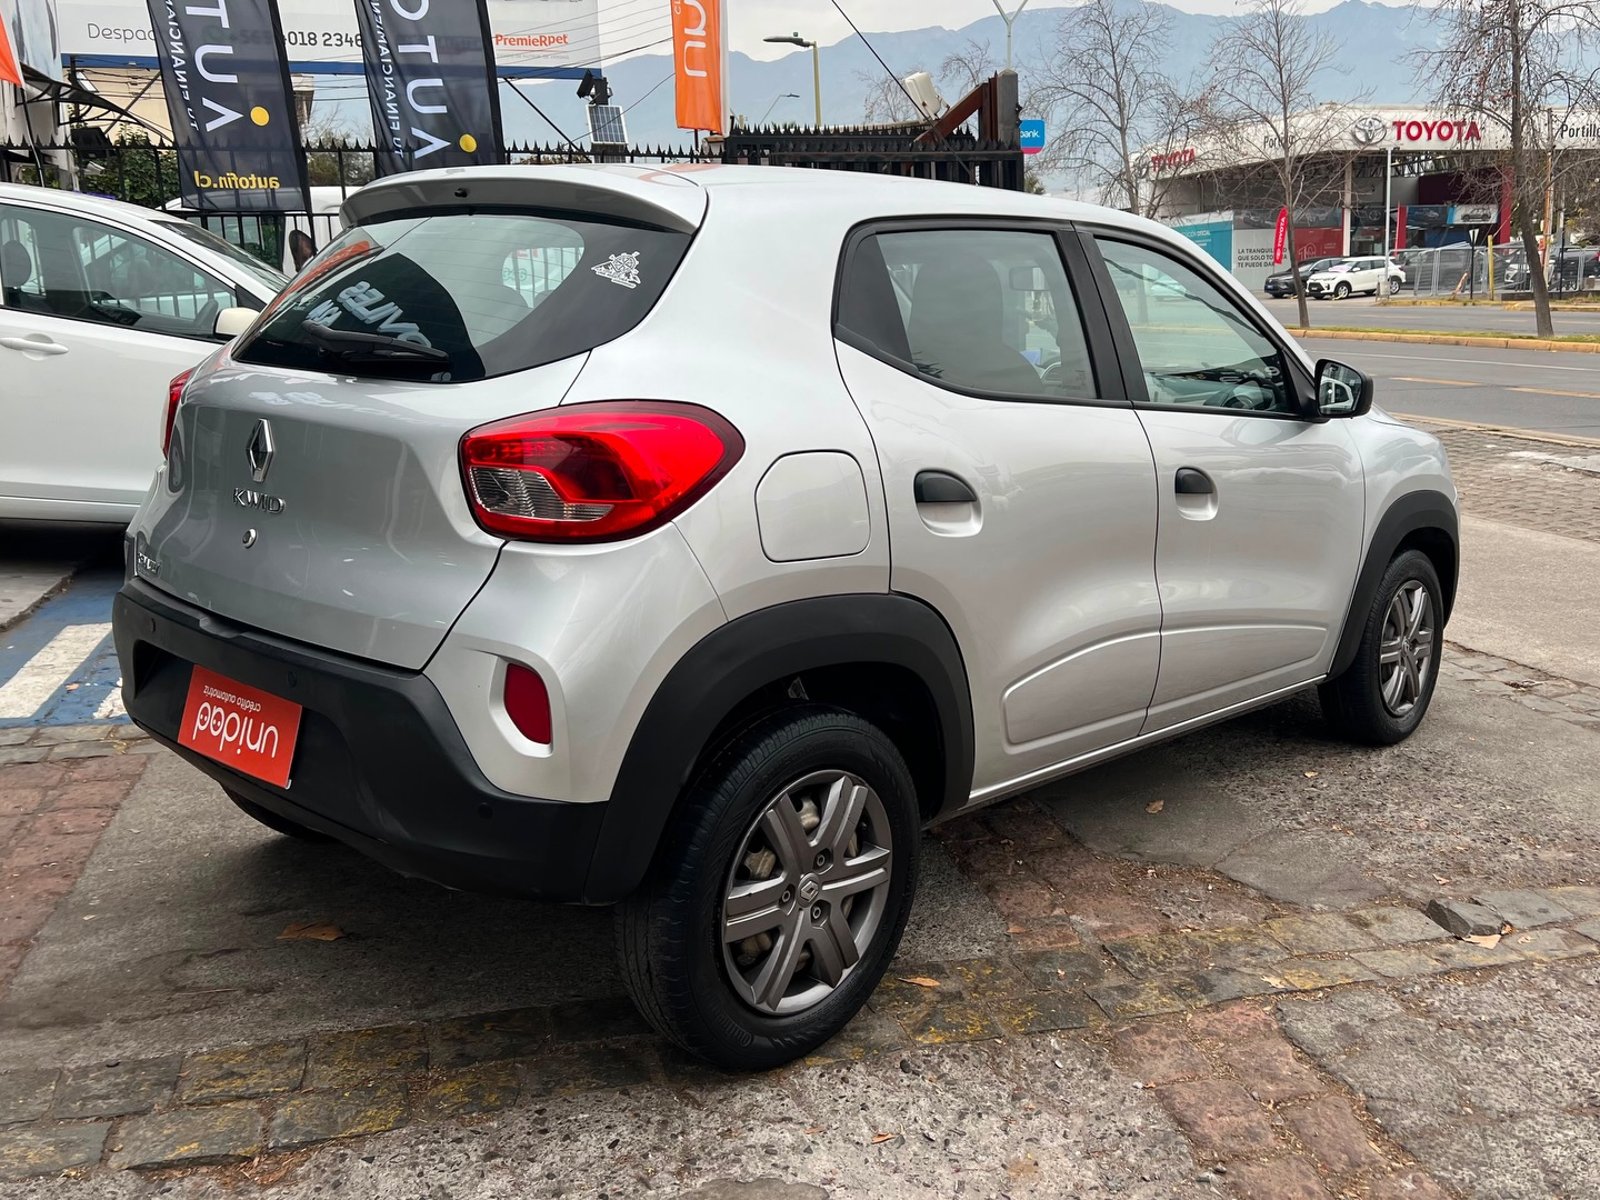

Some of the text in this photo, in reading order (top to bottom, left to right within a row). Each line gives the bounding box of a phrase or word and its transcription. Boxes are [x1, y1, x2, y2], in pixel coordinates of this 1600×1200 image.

[283, 31, 318, 46] 018
[495, 34, 568, 47] PremieRpet
[1392, 120, 1482, 142] TOYOTA
[1151, 147, 1196, 172] TOYOTA
[1277, 217, 1286, 248] TOYOTA
[233, 488, 286, 514] KWID
[203, 685, 262, 713] crédito automotriz
[192, 701, 279, 759] unidad
